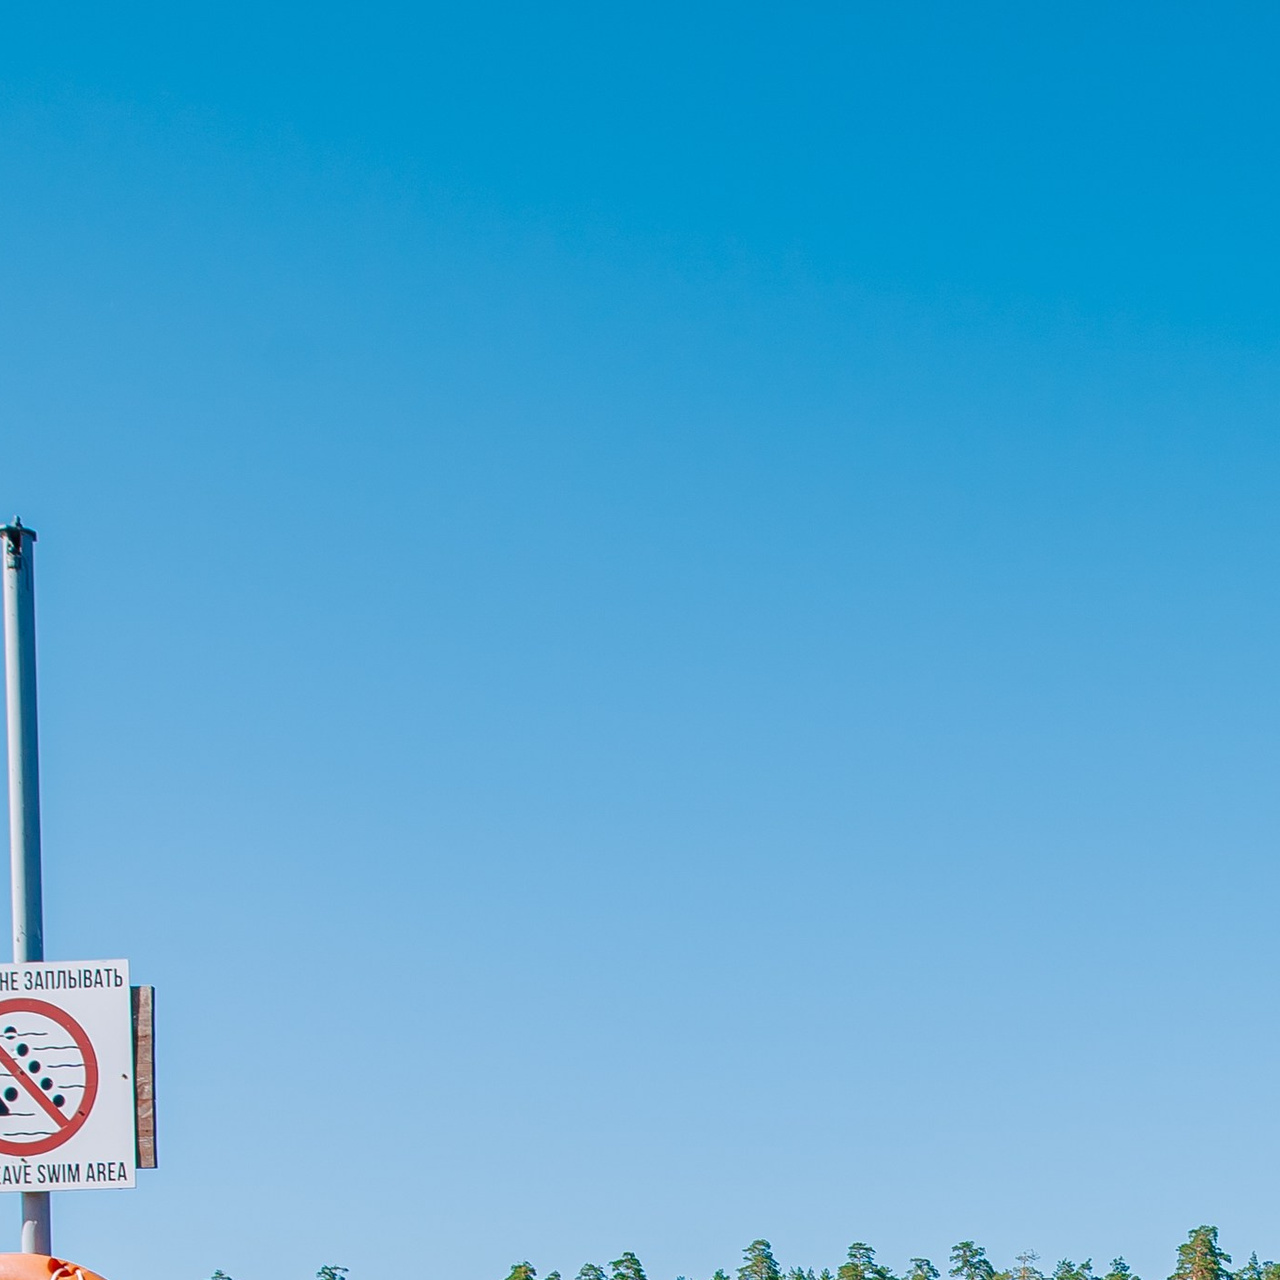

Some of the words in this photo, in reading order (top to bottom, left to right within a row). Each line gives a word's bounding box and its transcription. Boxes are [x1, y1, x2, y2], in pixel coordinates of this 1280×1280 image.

[0, 971, 19, 991] НЕ
[24, 968, 123, 990] ЗАПЛЫВАТЬ
[0, 1165, 32, 1185] AVE
[37, 1162, 81, 1184] SWIM
[86, 1161, 128, 1182] AREA
